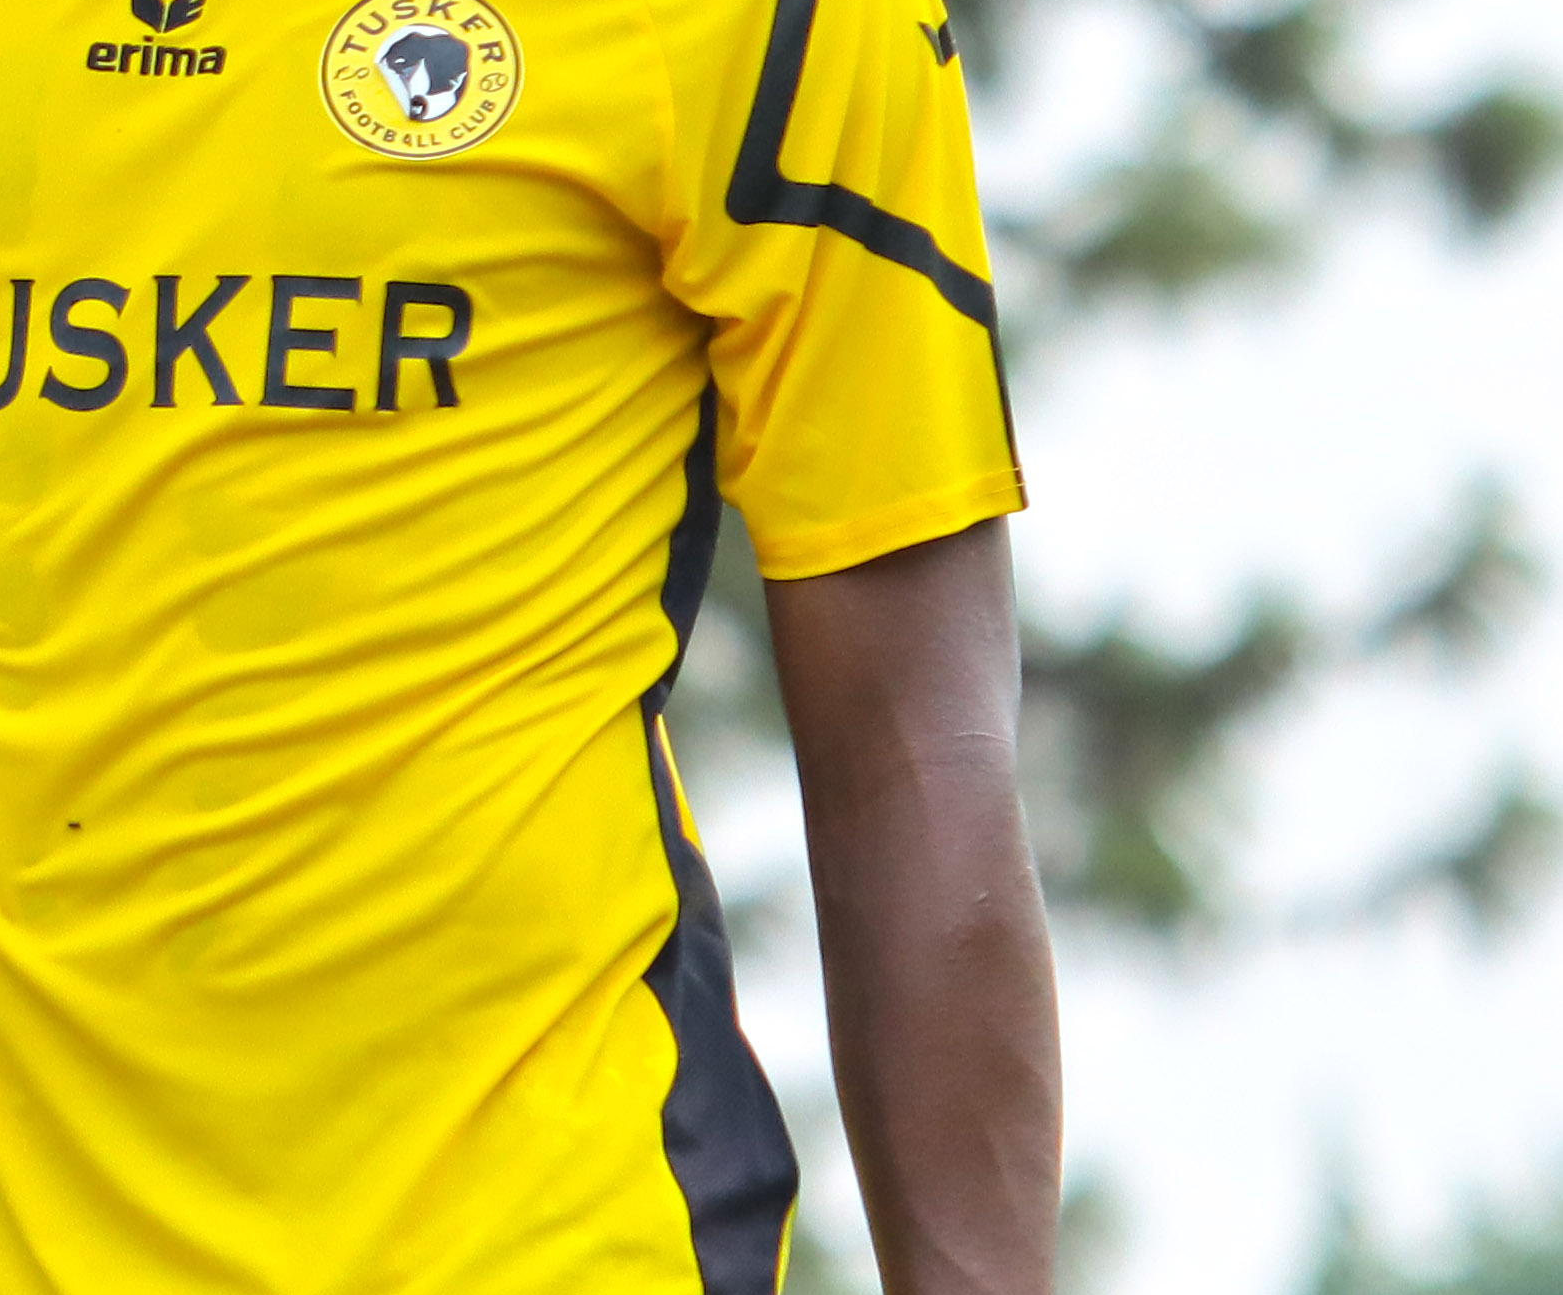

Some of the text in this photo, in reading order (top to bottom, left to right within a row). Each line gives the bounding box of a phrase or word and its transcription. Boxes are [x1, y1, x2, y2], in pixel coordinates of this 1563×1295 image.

[87, 35, 227, 77] erima
[340, 89, 496, 147] FOOTBALL CLUB
